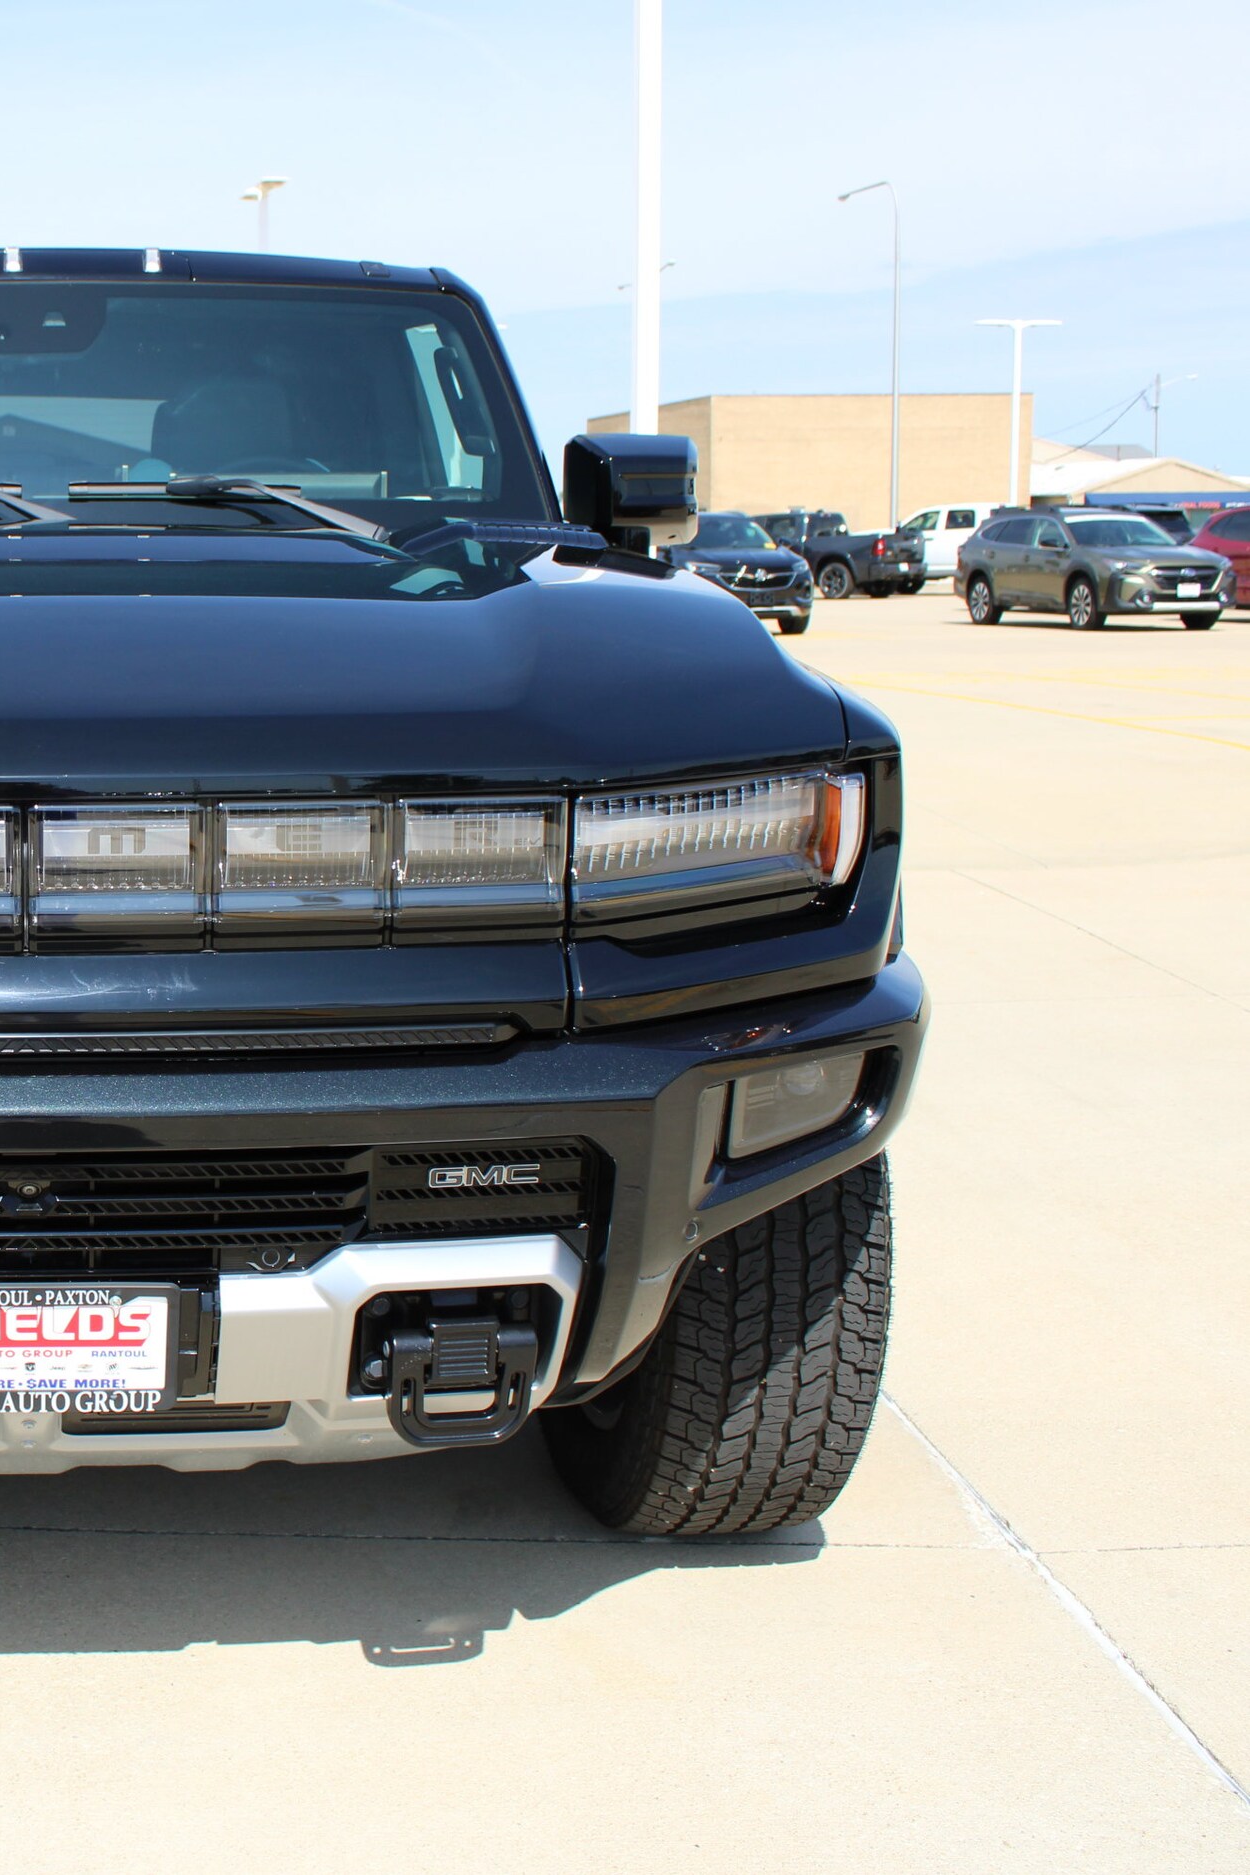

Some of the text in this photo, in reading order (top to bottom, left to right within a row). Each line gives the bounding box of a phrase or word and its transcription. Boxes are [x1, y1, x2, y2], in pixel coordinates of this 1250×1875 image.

[428, 1163, 541, 1188] GMC
[44, 1290, 110, 1305] PAXTON
[22, 1350, 73, 1358] GROUP
[74, 1379, 126, 1389] MORE!
[0, 1390, 71, 1414] AUTO
[74, 1390, 162, 1414] GROUP
